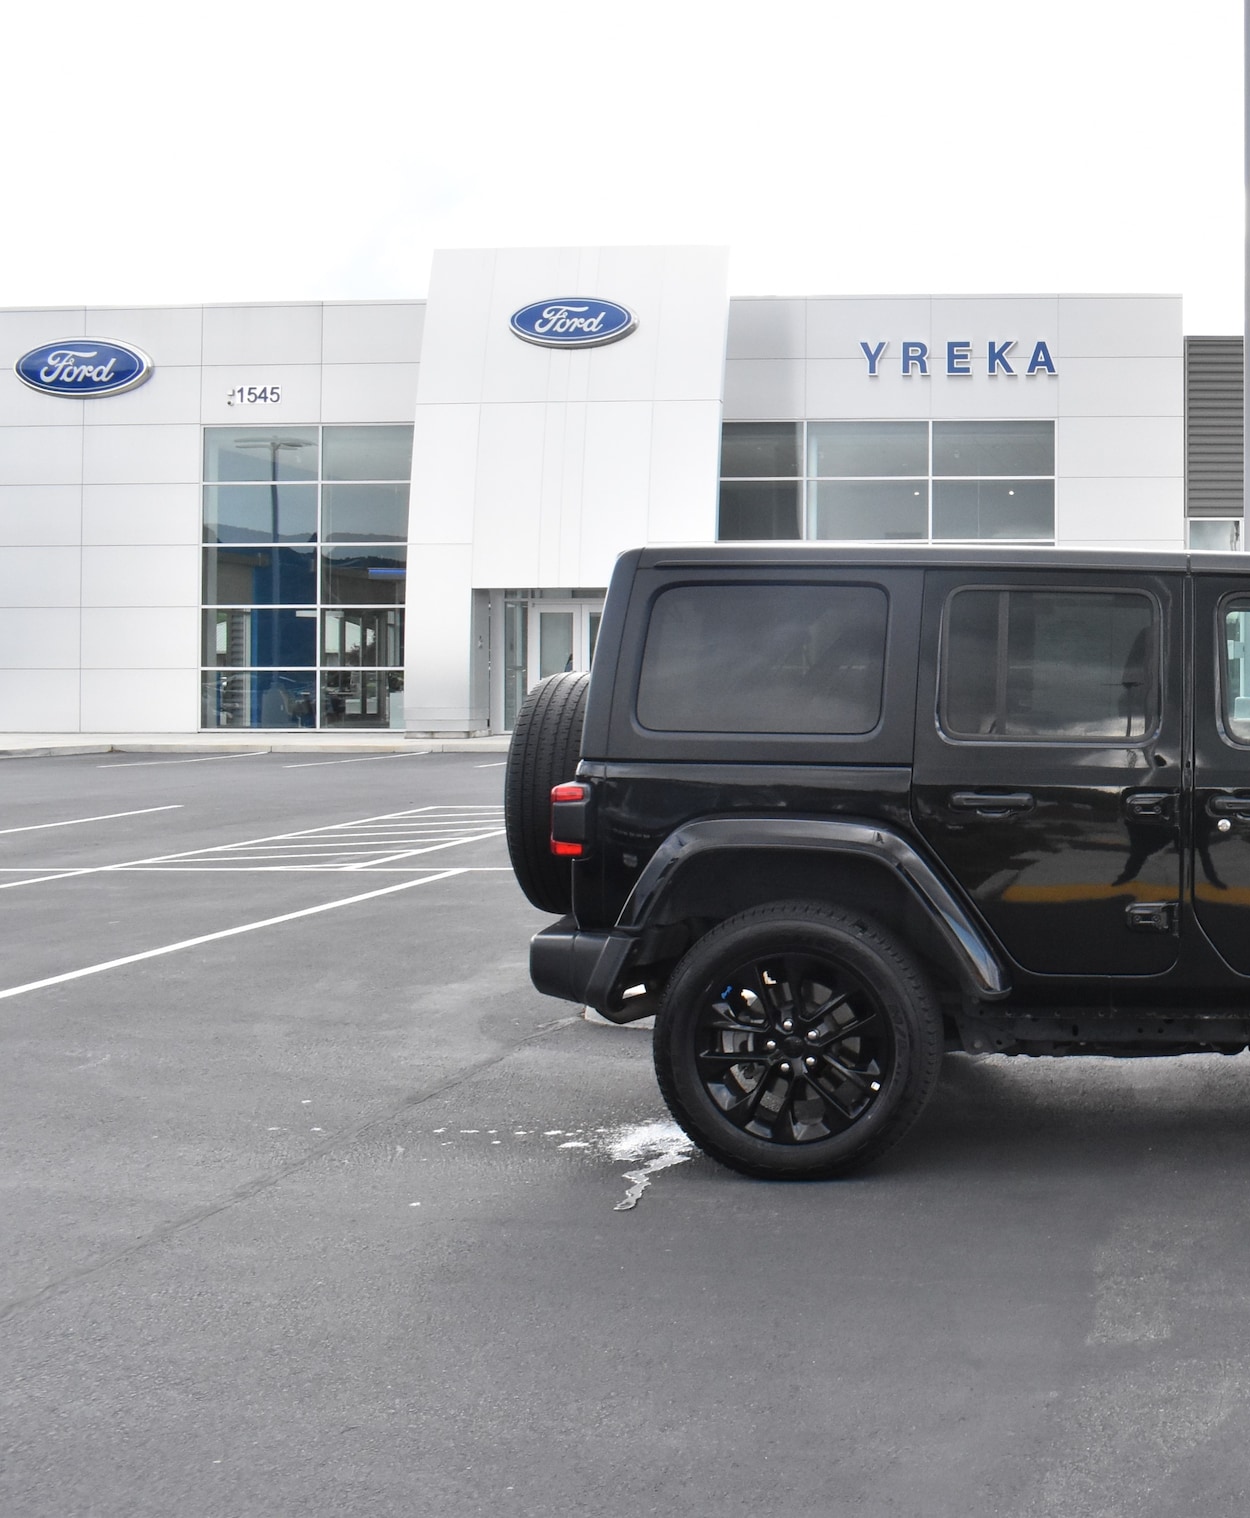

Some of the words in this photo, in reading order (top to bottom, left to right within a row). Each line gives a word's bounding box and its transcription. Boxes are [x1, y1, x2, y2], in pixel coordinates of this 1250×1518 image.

[534, 305, 607, 333] Ford
[40, 350, 117, 383] Ford
[859, 340, 1058, 376] YREKA
[237, 386, 280, 403] 1545
